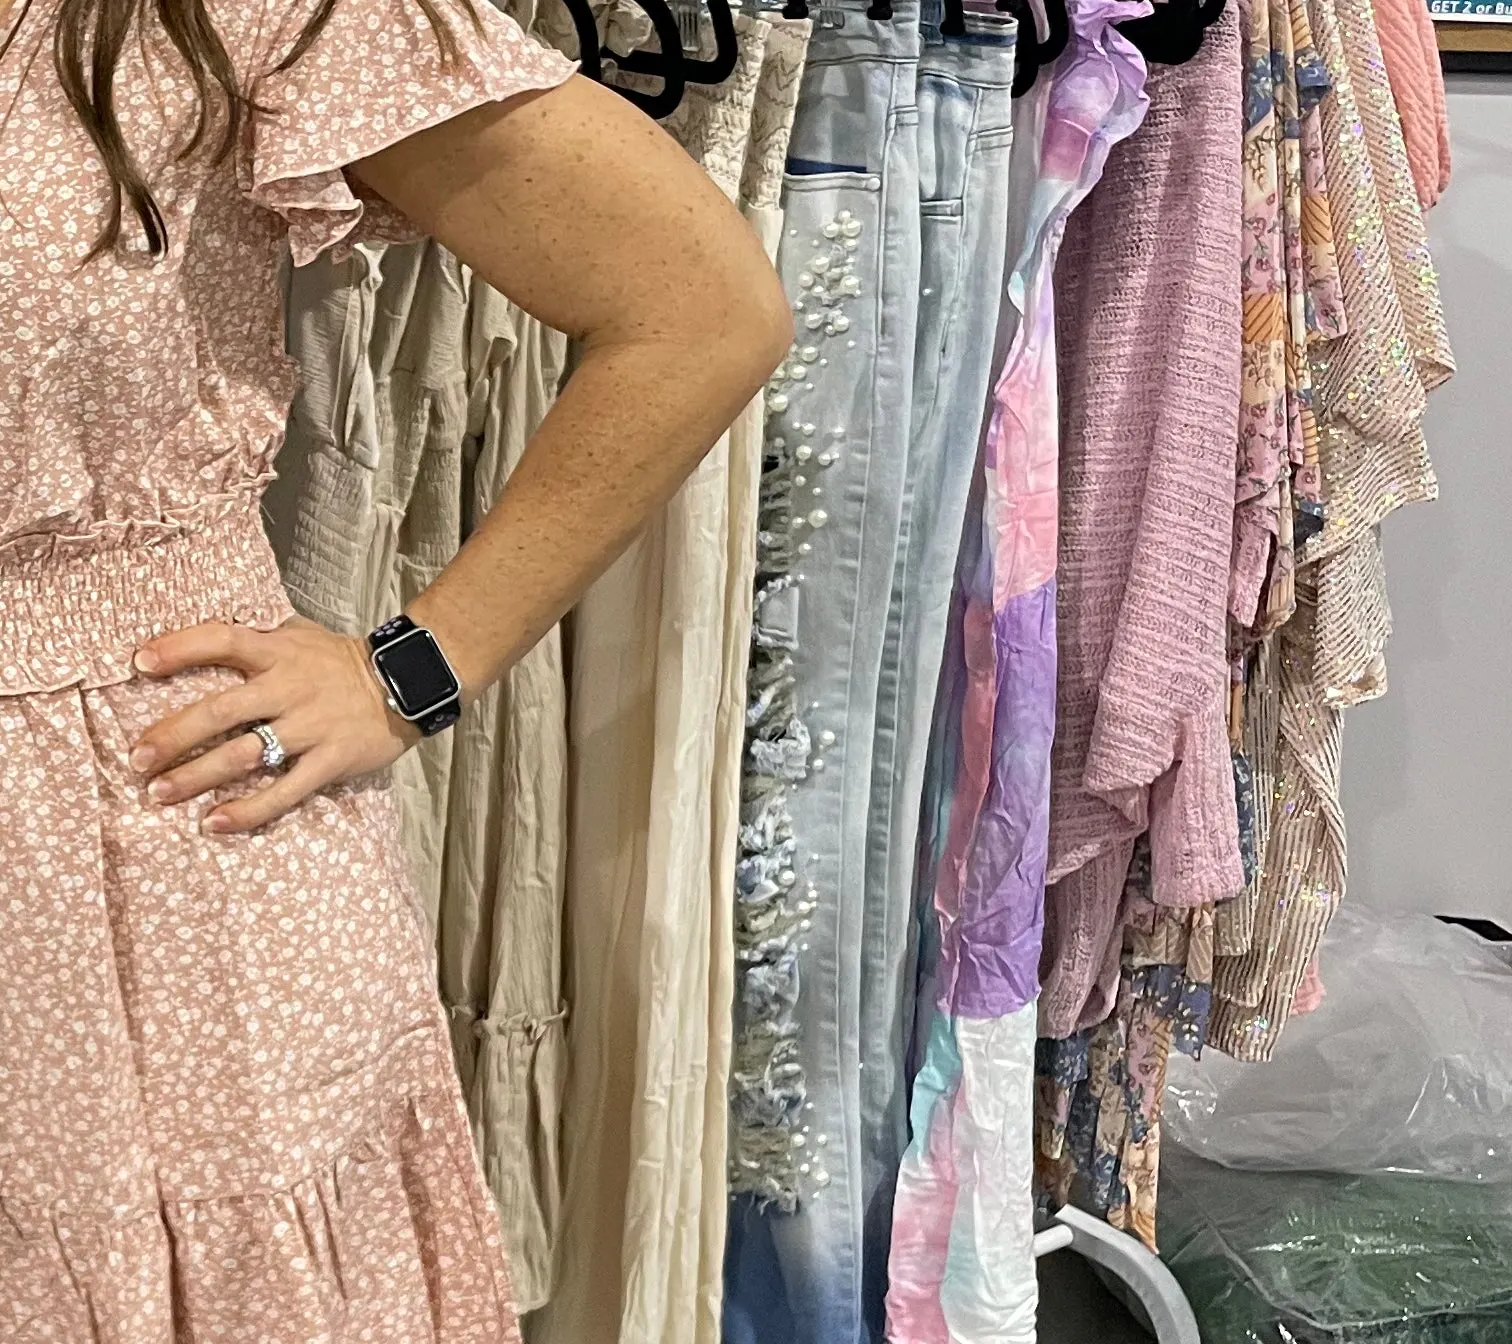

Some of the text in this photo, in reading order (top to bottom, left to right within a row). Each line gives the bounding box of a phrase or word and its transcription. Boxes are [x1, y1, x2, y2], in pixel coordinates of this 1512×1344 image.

[1431, 0, 1460, 13] GET
[1462, 0, 1473, 14] 2
[1475, 4, 1493, 15] or
